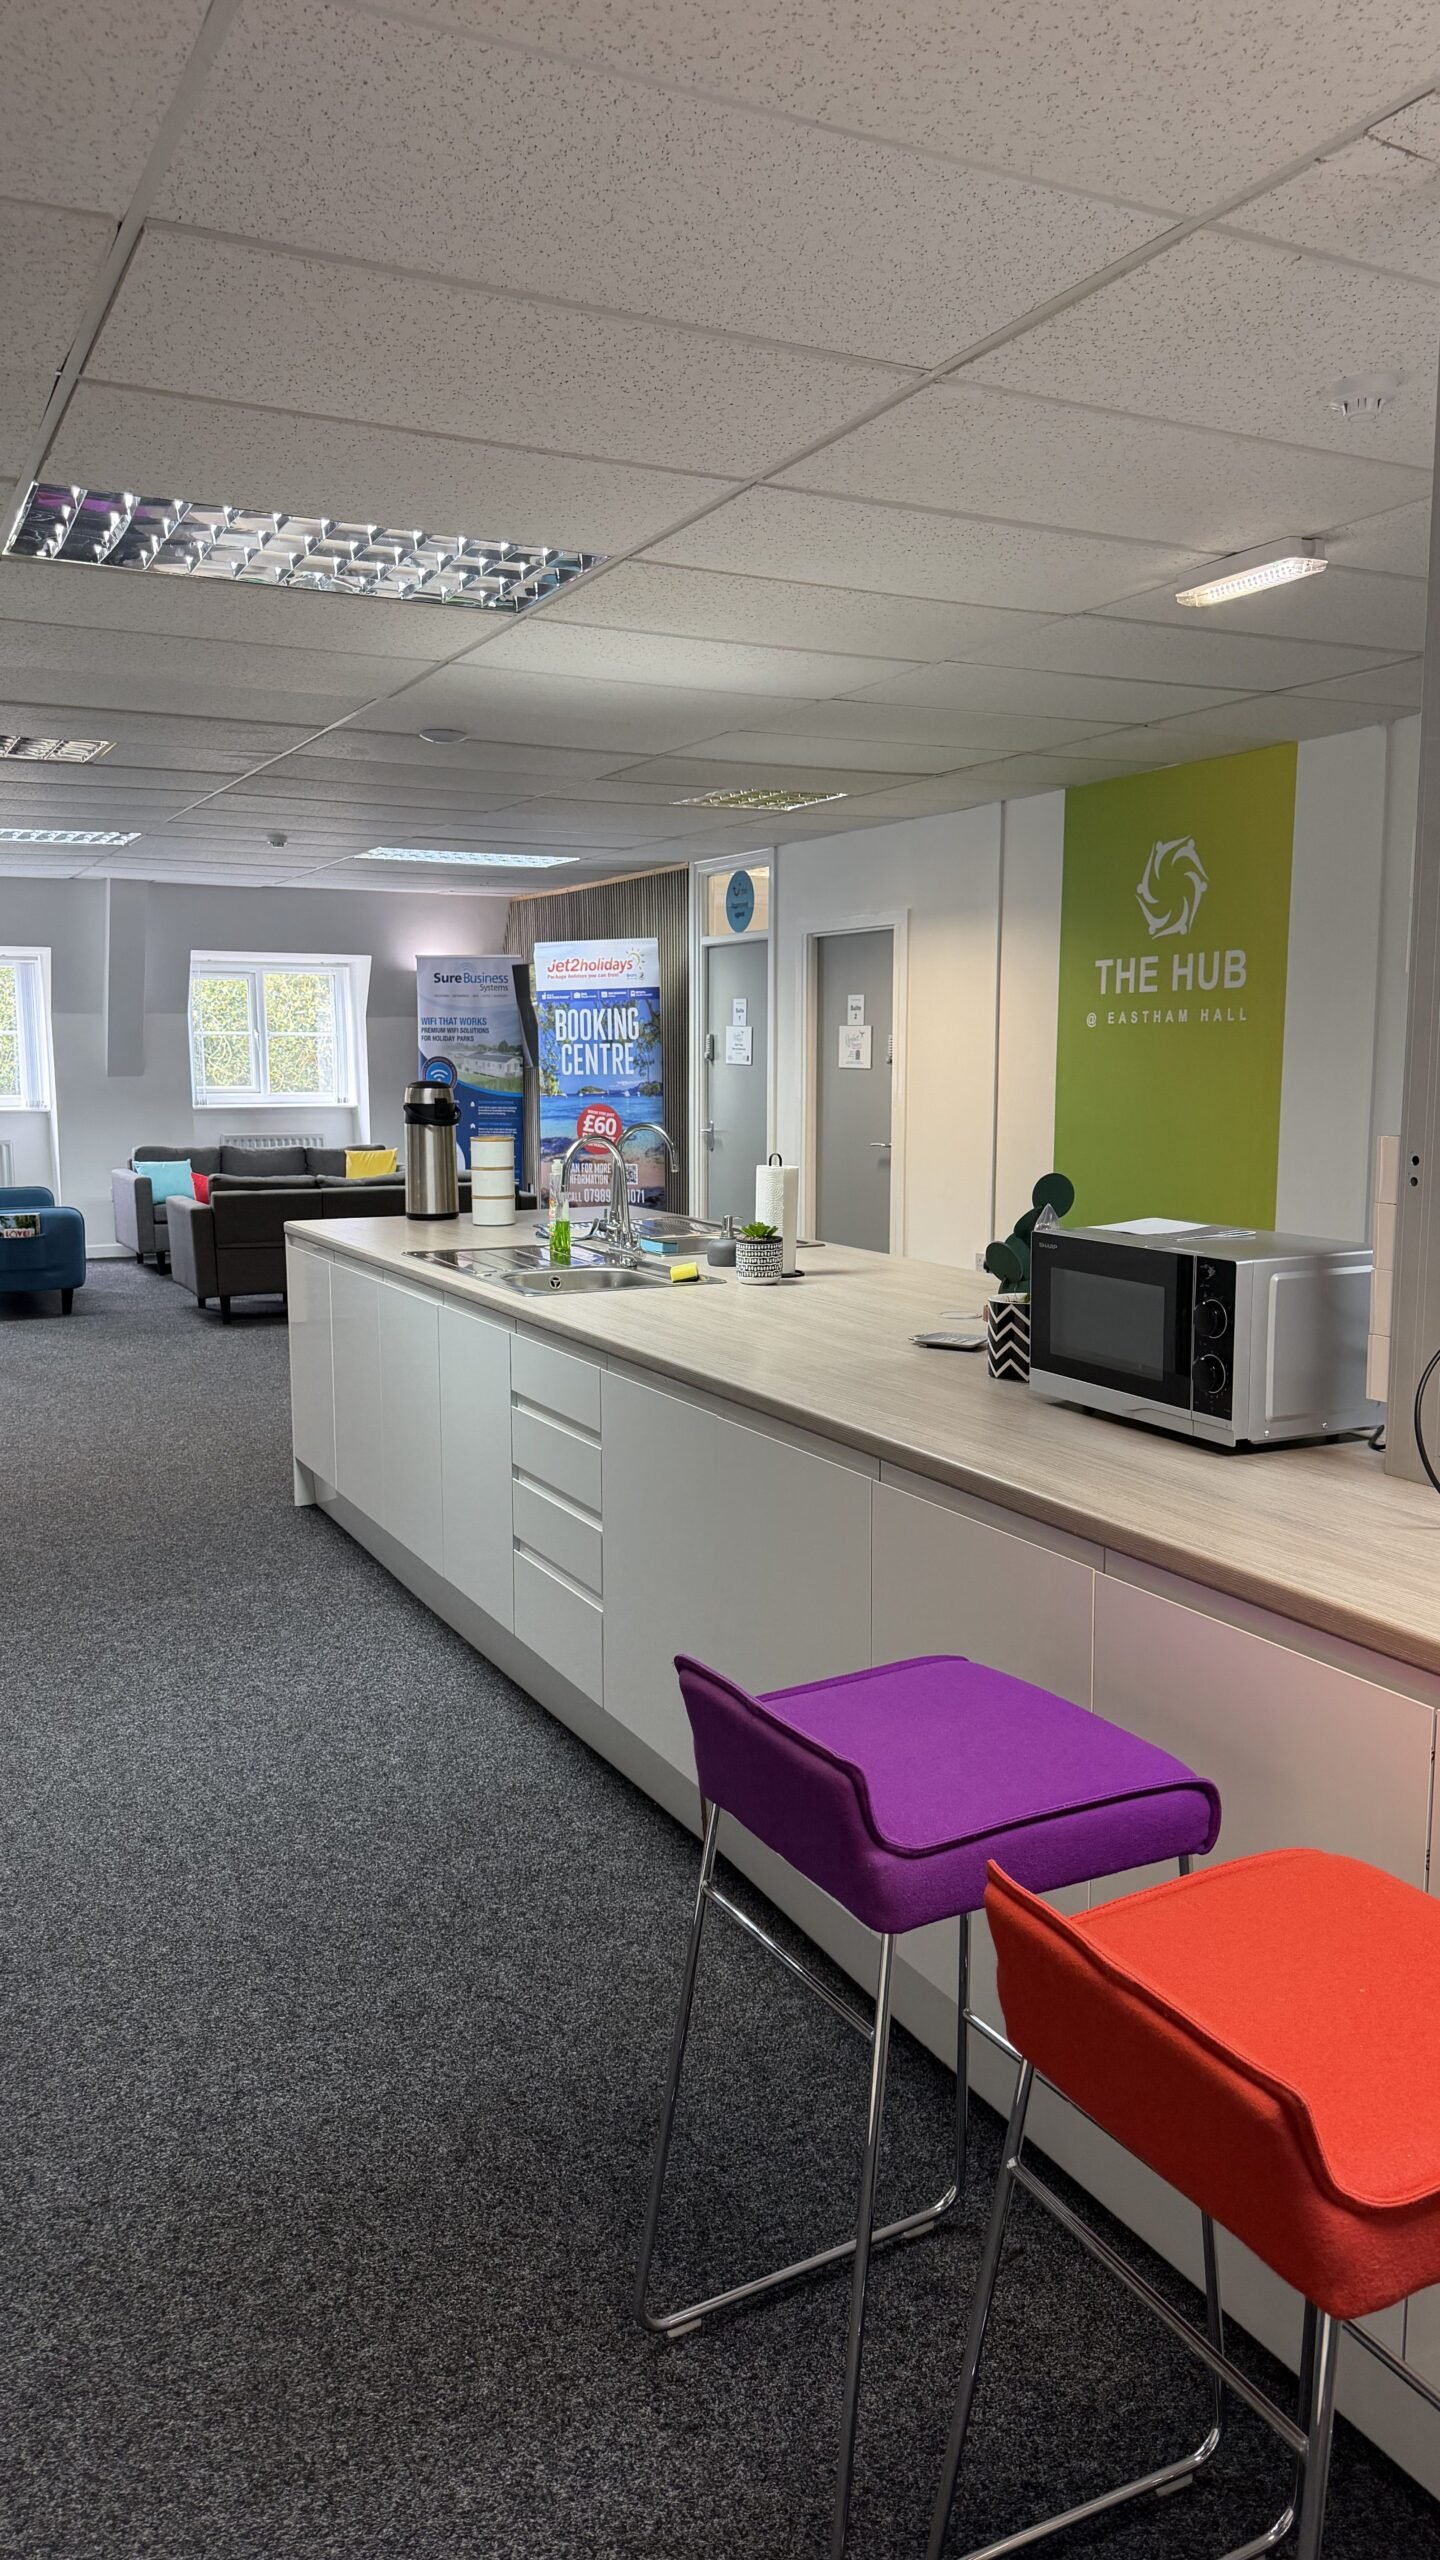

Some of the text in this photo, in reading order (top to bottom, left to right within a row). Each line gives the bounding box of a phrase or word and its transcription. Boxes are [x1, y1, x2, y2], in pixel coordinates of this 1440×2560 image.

[433, 971, 509, 983] Sure Business
[1095, 949, 1247, 995] THE HUB
[480, 984, 509, 992] Systems
[421, 1016, 487, 1026] WIFI THAT WORKS
[555, 1007, 639, 1041] BOOKING
[1086, 1007, 1247, 1028] @ EASTHAM HALL
[561, 1042, 635, 1076] CENTRE
[582, 1114, 617, 1136] £60
[570, 1162, 611, 1174] AN FOR MORE
[569, 1174, 609, 1184] NFORMATION
[568, 1192, 582, 1202] CALL
[584, 1188, 611, 1202] 07989
[627, 1189, 645, 1203] 1071
